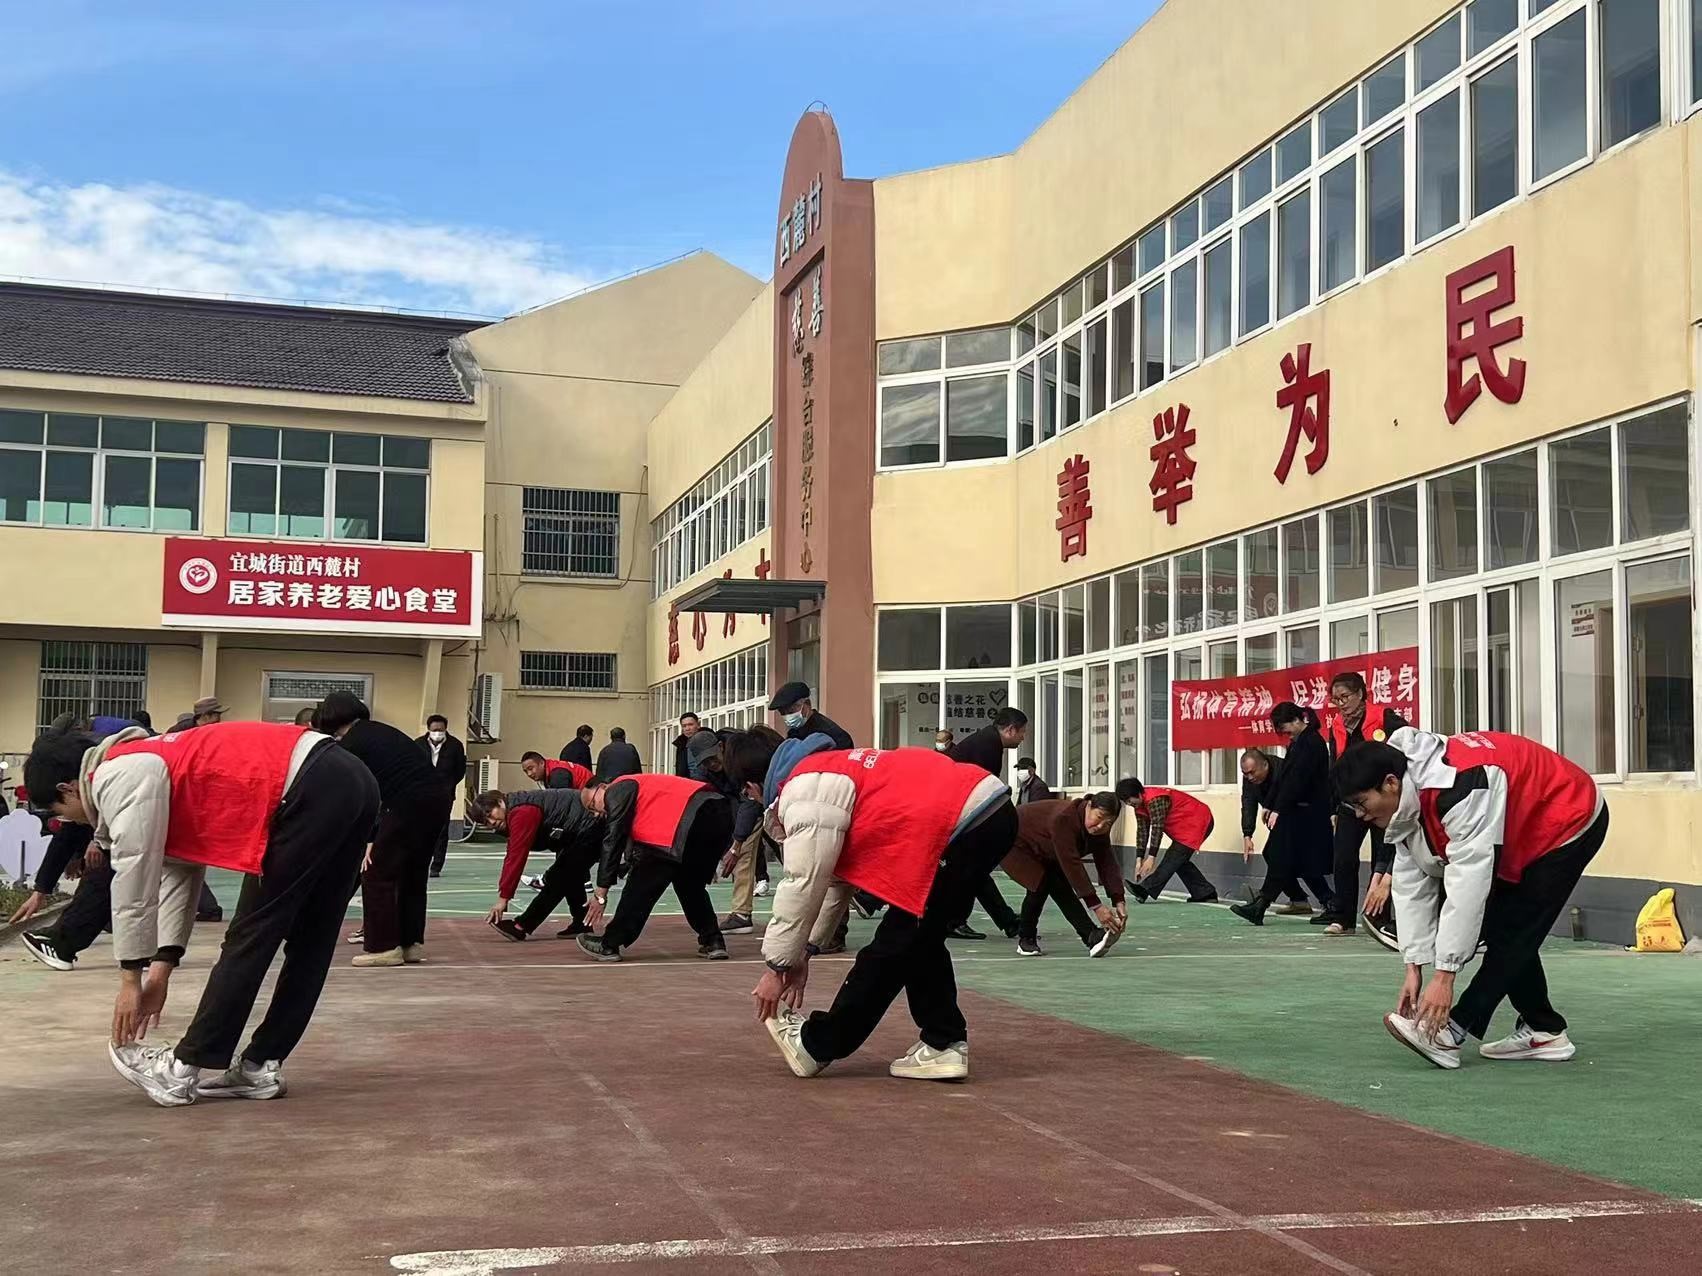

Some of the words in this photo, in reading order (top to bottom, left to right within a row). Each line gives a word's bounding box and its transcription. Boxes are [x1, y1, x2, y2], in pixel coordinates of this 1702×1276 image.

[780, 172, 823, 268] 西麓村
[1055, 245, 1527, 563] 善举为民
[229, 552, 361, 578] 宜城街道西麓村
[228, 580, 458, 614] 居家养老爱心食堂
[1180, 685, 1273, 721] 弘扬体育精神
[1290, 664, 1418, 710] 促进健身
